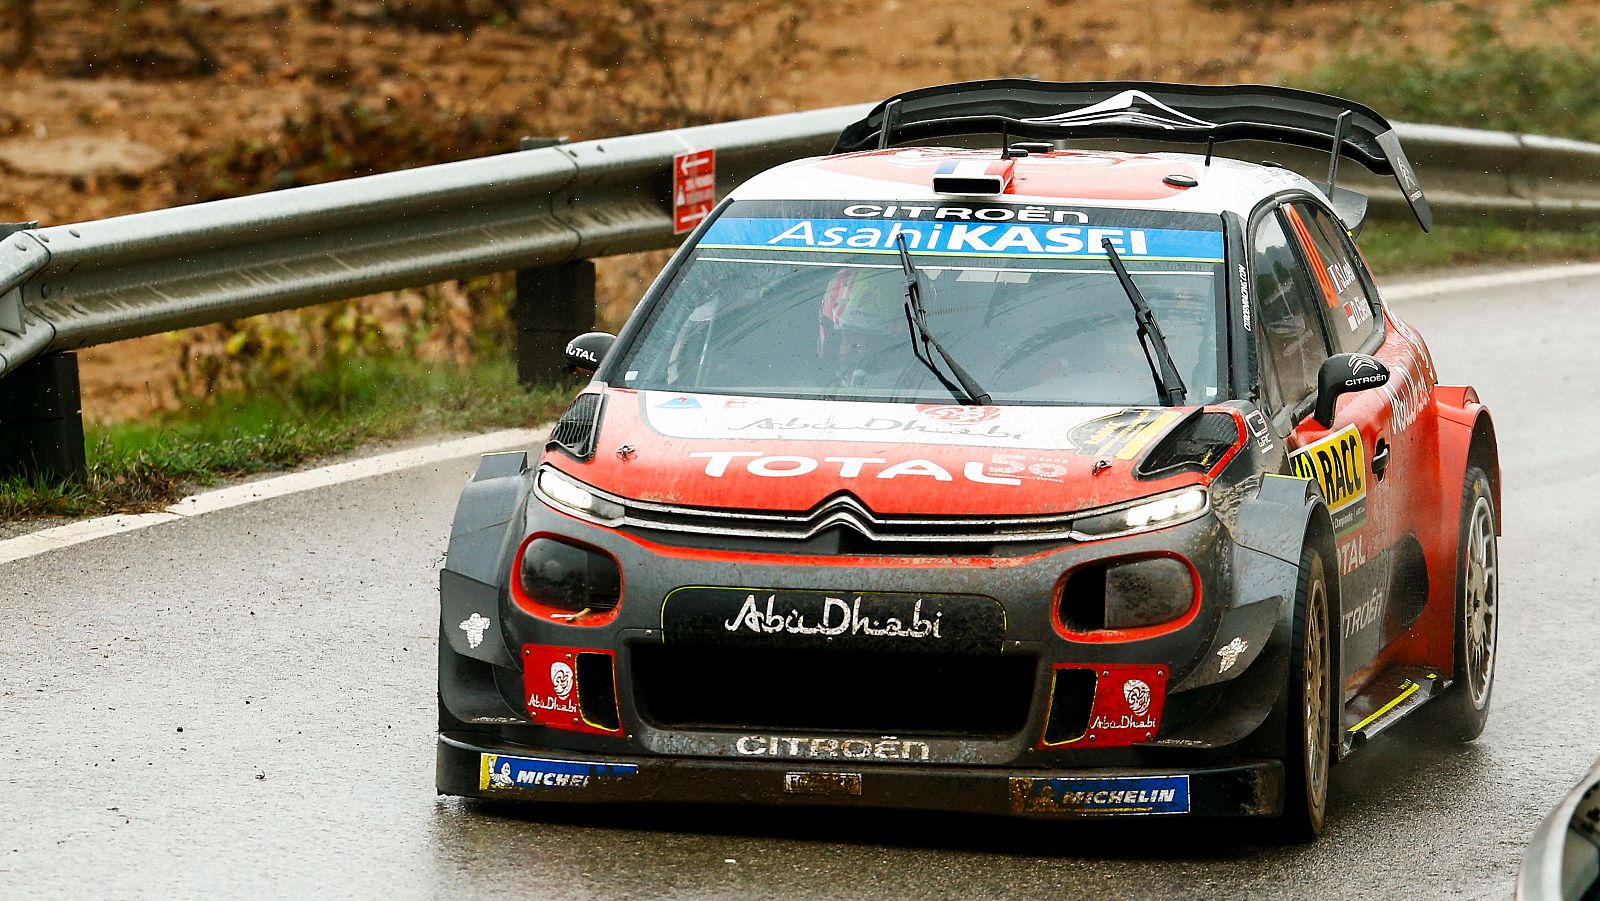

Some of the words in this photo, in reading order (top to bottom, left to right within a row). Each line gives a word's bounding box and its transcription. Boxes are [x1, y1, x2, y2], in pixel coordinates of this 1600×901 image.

[843, 203, 1090, 225] CITROËN
[767, 220, 1149, 256] AsahiKASEI
[565, 343, 598, 363] TOTAL
[690, 451, 1022, 486] TOTAL
[1316, 434, 1362, 506] RACC
[1337, 535, 1366, 576] TAL
[1062, 788, 1177, 805] MICHELIN
